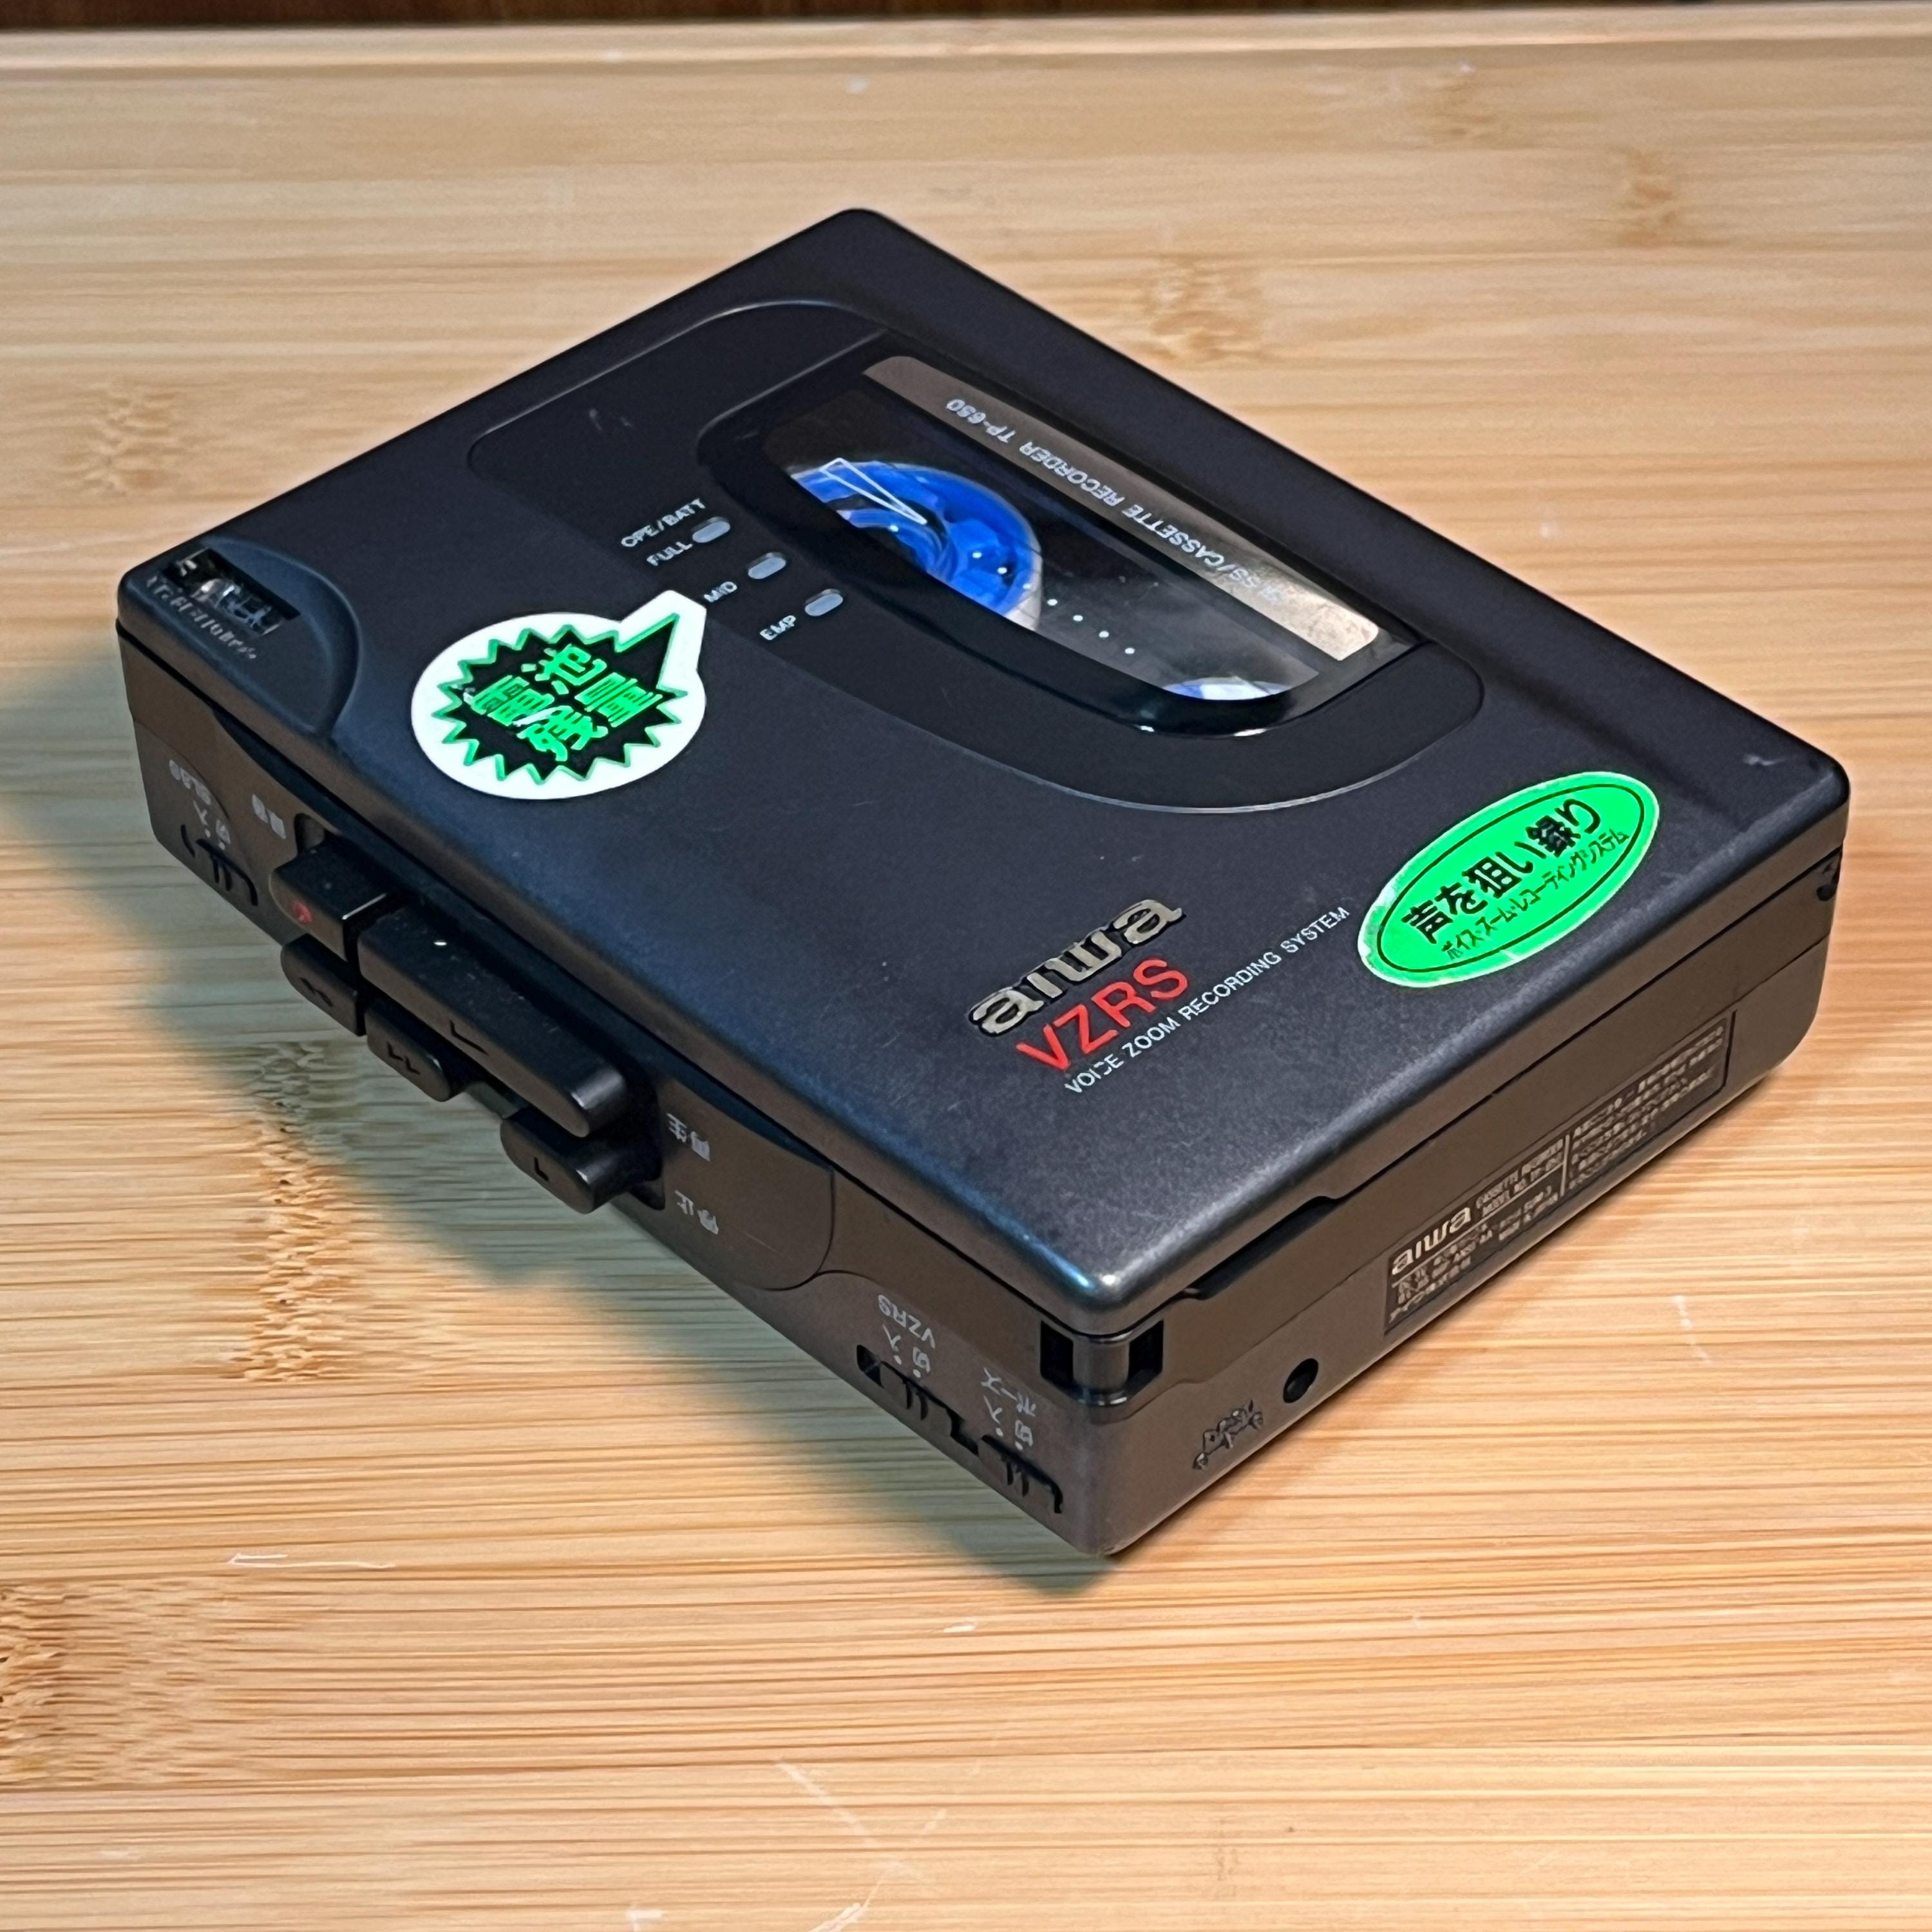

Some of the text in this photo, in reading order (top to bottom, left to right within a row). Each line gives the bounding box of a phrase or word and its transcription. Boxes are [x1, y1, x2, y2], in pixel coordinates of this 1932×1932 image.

[1019, 442, 1125, 507] RECORDER
[621, 497, 706, 547] OPE/BATT
[647, 541, 693, 566] FULL
[759, 614, 797, 641] EMP
[512, 672, 663, 762] 残量
[1401, 798, 1602, 945] 声を狙い録り
[968, 898, 1187, 1036] aiwa
[1064, 905, 1350, 1094] VOICE ZOOM RECORDING SYSTEM
[1015, 958, 1189, 1074] VZRS
[1391, 1206, 1472, 1276] aiwa
[877, 1294, 936, 1350] VZRS
